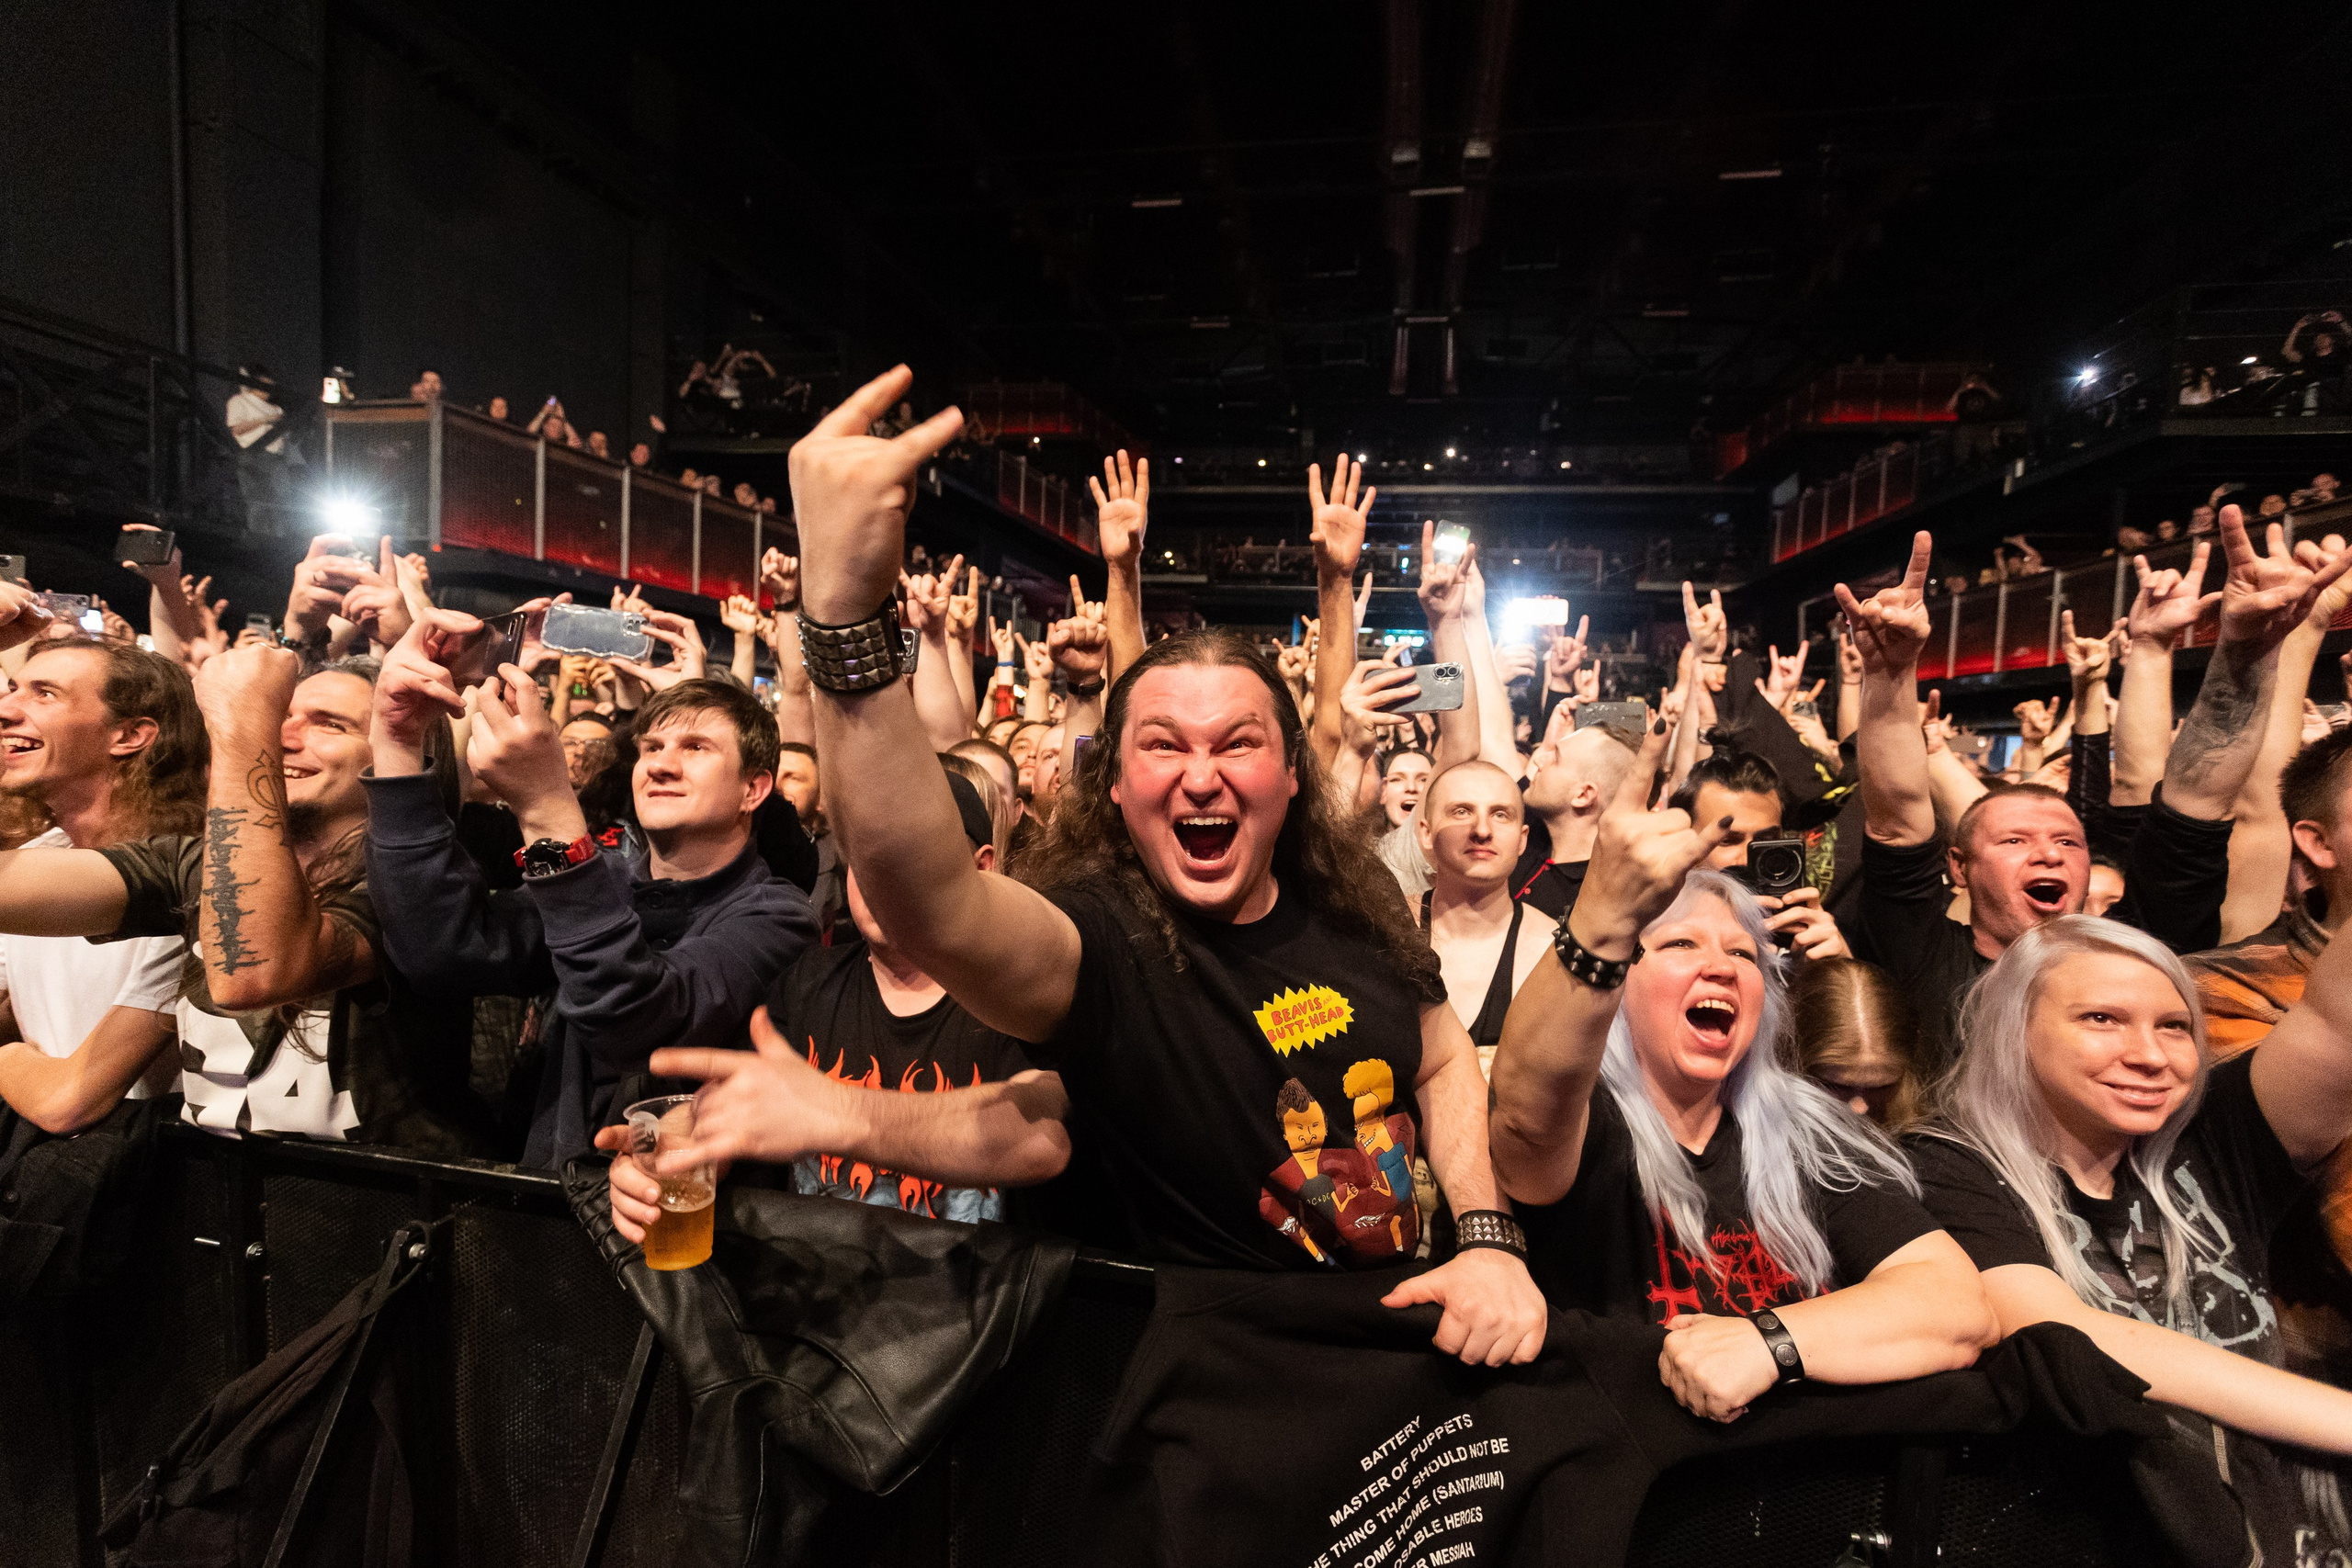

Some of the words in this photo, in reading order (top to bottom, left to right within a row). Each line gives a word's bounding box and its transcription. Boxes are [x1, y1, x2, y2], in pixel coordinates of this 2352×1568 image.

[1266, 1006, 1344, 1043] BUTT-HEAD
[1271, 997, 1322, 1026] BEAVIS
[1360, 1416, 1420, 1472] BATTERY
[1329, 1476, 1391, 1528] MASTER
[1391, 1457, 1409, 1481] OF
[1409, 1414, 1474, 1461] PUPPETS
[1329, 1518, 1377, 1558] THING
[1376, 1486, 1410, 1524] THAT
[1412, 1446, 1467, 1489] SHOULD
[1469, 1440, 1488, 1459] NOT
[1490, 1438, 1510, 1454] BE
[1395, 1495, 1431, 1541] HOME
[1443, 1506, 1484, 1530] HEROES
[1429, 1541, 1476, 1567] MESSIAH
